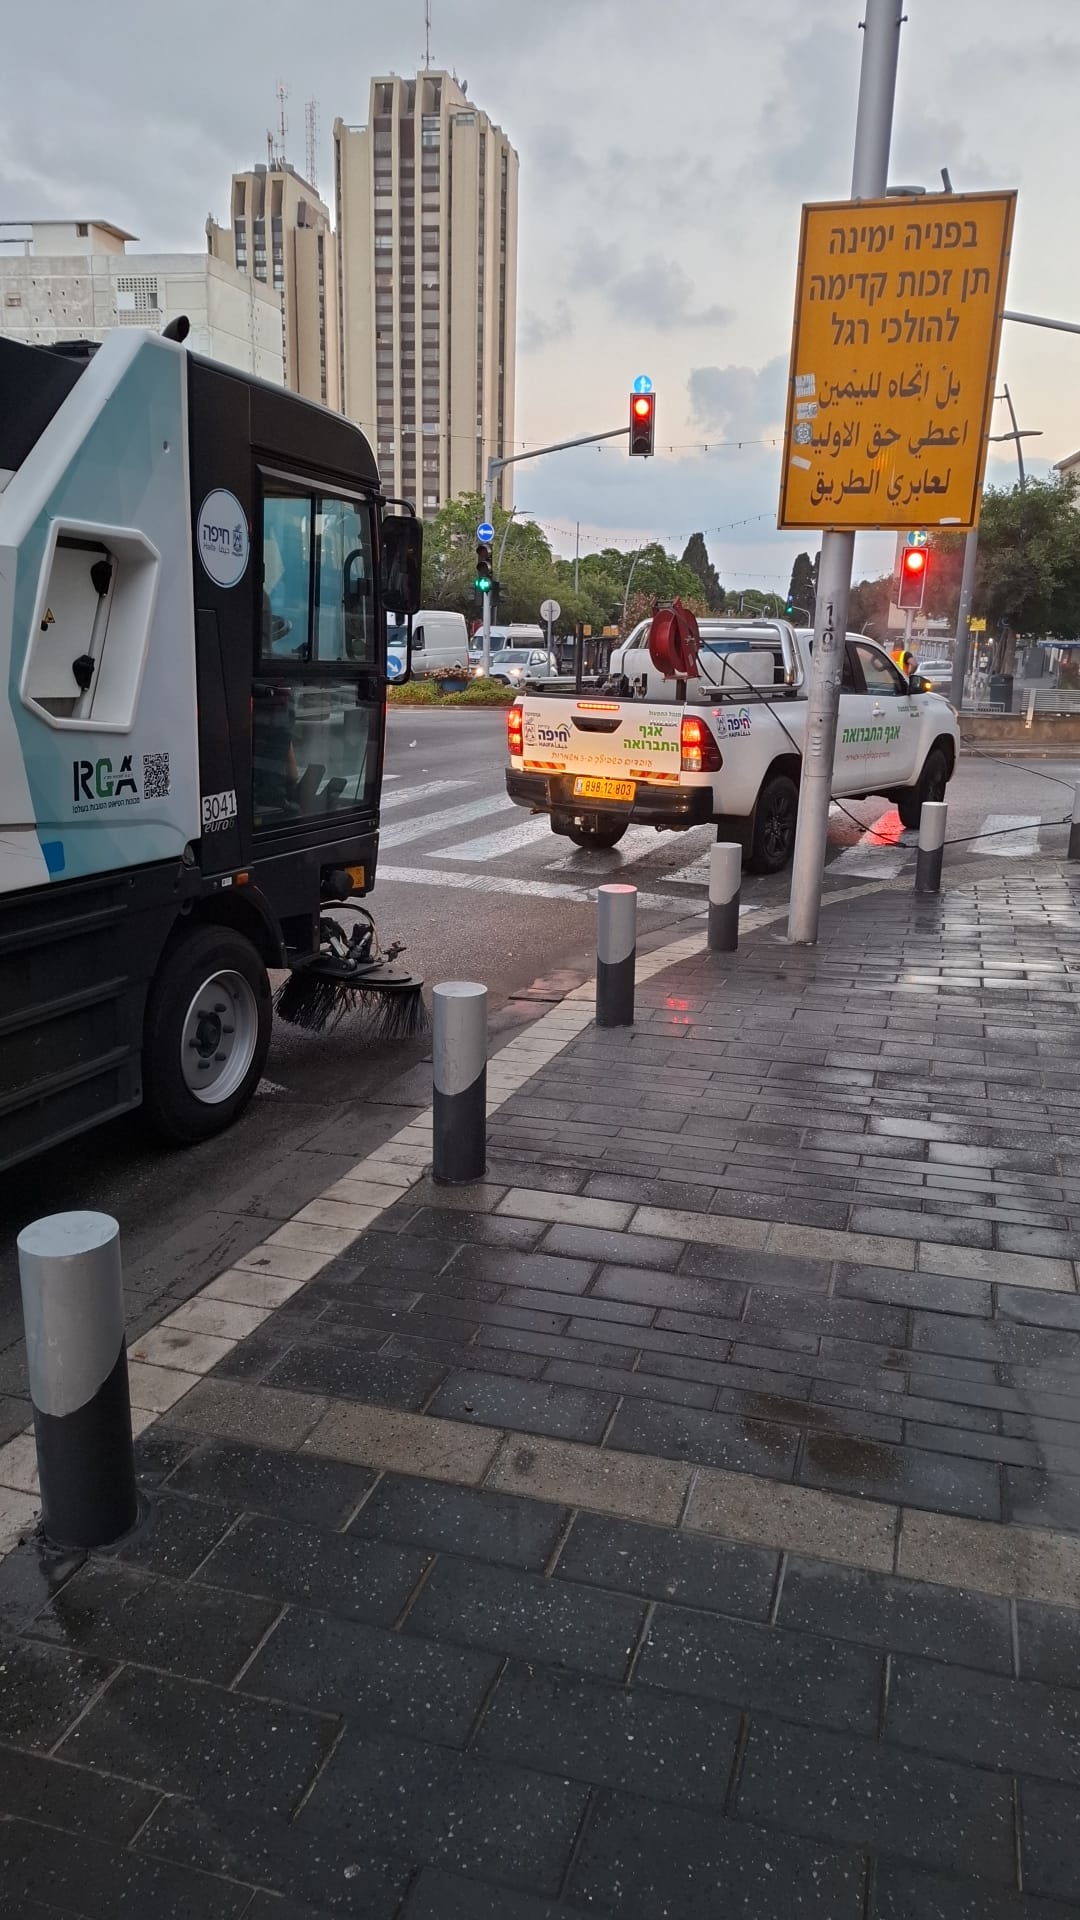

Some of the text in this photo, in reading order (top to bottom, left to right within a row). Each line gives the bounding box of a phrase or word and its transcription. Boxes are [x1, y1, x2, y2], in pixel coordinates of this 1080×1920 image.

[829, 220, 978, 255] בפניה ימינה
[809, 267, 990, 307] תן זכות קדימה
[831, 308, 960, 346] להולכי רגל
[818, 370, 882, 409] لليمين
[888, 362, 930, 402] اتجاه
[809, 420, 861, 458] الاولي
[866, 423, 902, 459] حق
[908, 419, 969, 459] اعطي
[810, 467, 952, 506] لعابري الطريق
[203, 524, 230, 545] חיפה
[537, 729, 568, 743] חיפה
[639, 725, 663, 739] אגף
[727, 718, 751, 731] חיפה
[842, 725, 901, 744] אגף התברואה
[623, 739, 680, 752] התברואה
[204, 792, 236, 821] 3041
